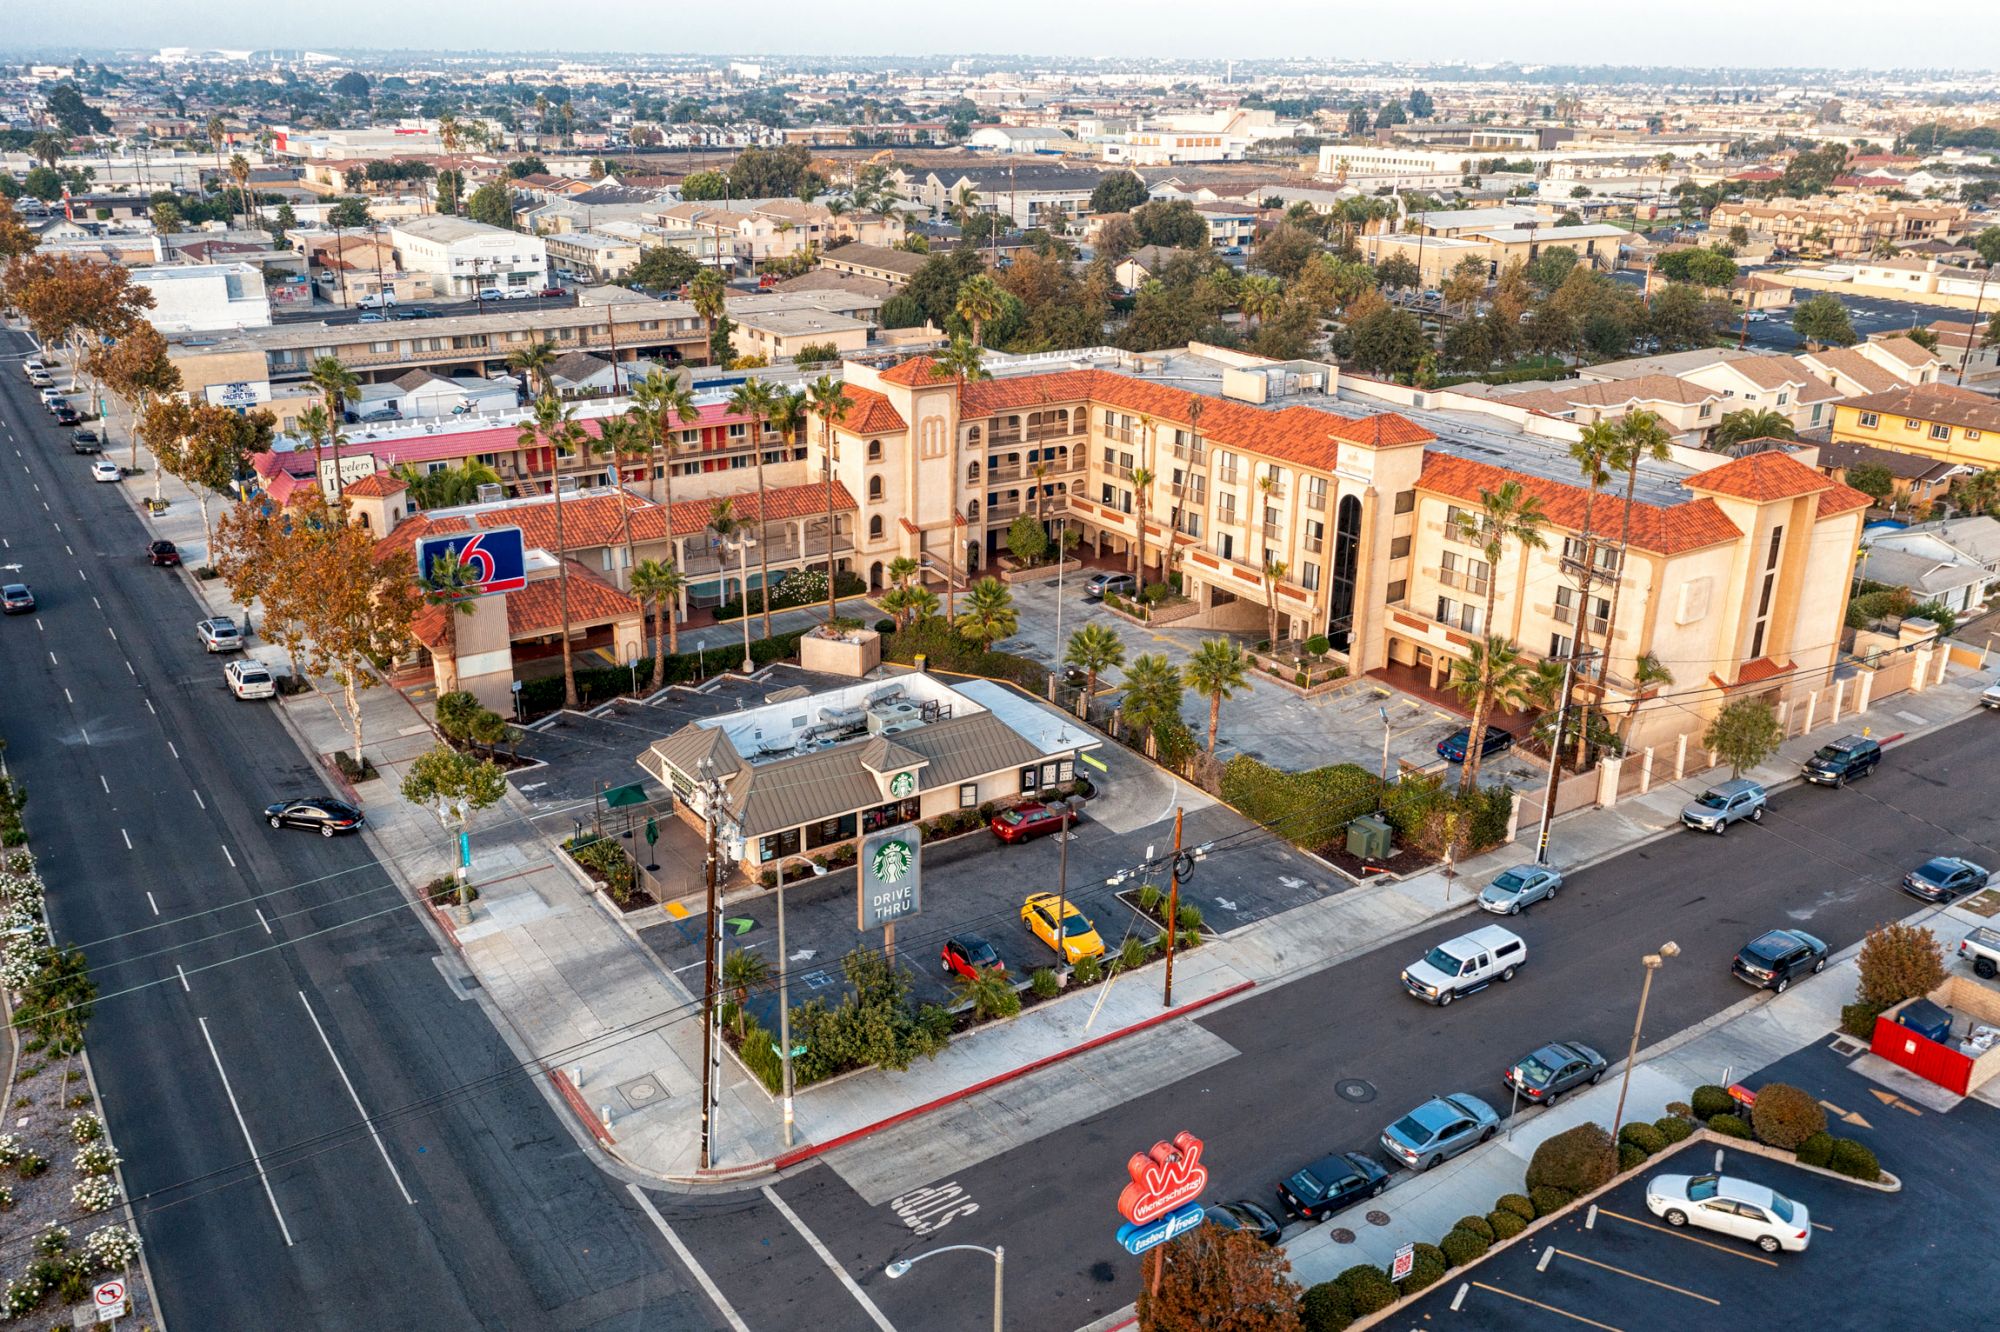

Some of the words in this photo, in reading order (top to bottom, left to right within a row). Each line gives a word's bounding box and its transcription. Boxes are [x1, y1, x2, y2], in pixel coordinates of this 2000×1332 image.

[323, 461, 370, 475] Trvelers
[457, 533, 495, 584] 6
[873, 886, 912, 907] DRIVE
[875, 899, 910, 919] THRU
[891, 1181, 980, 1235] STOP
[1137, 1176, 1201, 1216] Wienerschnitzel
[1135, 1230, 1165, 1252] tastee
[1175, 1212, 1199, 1231] freez
